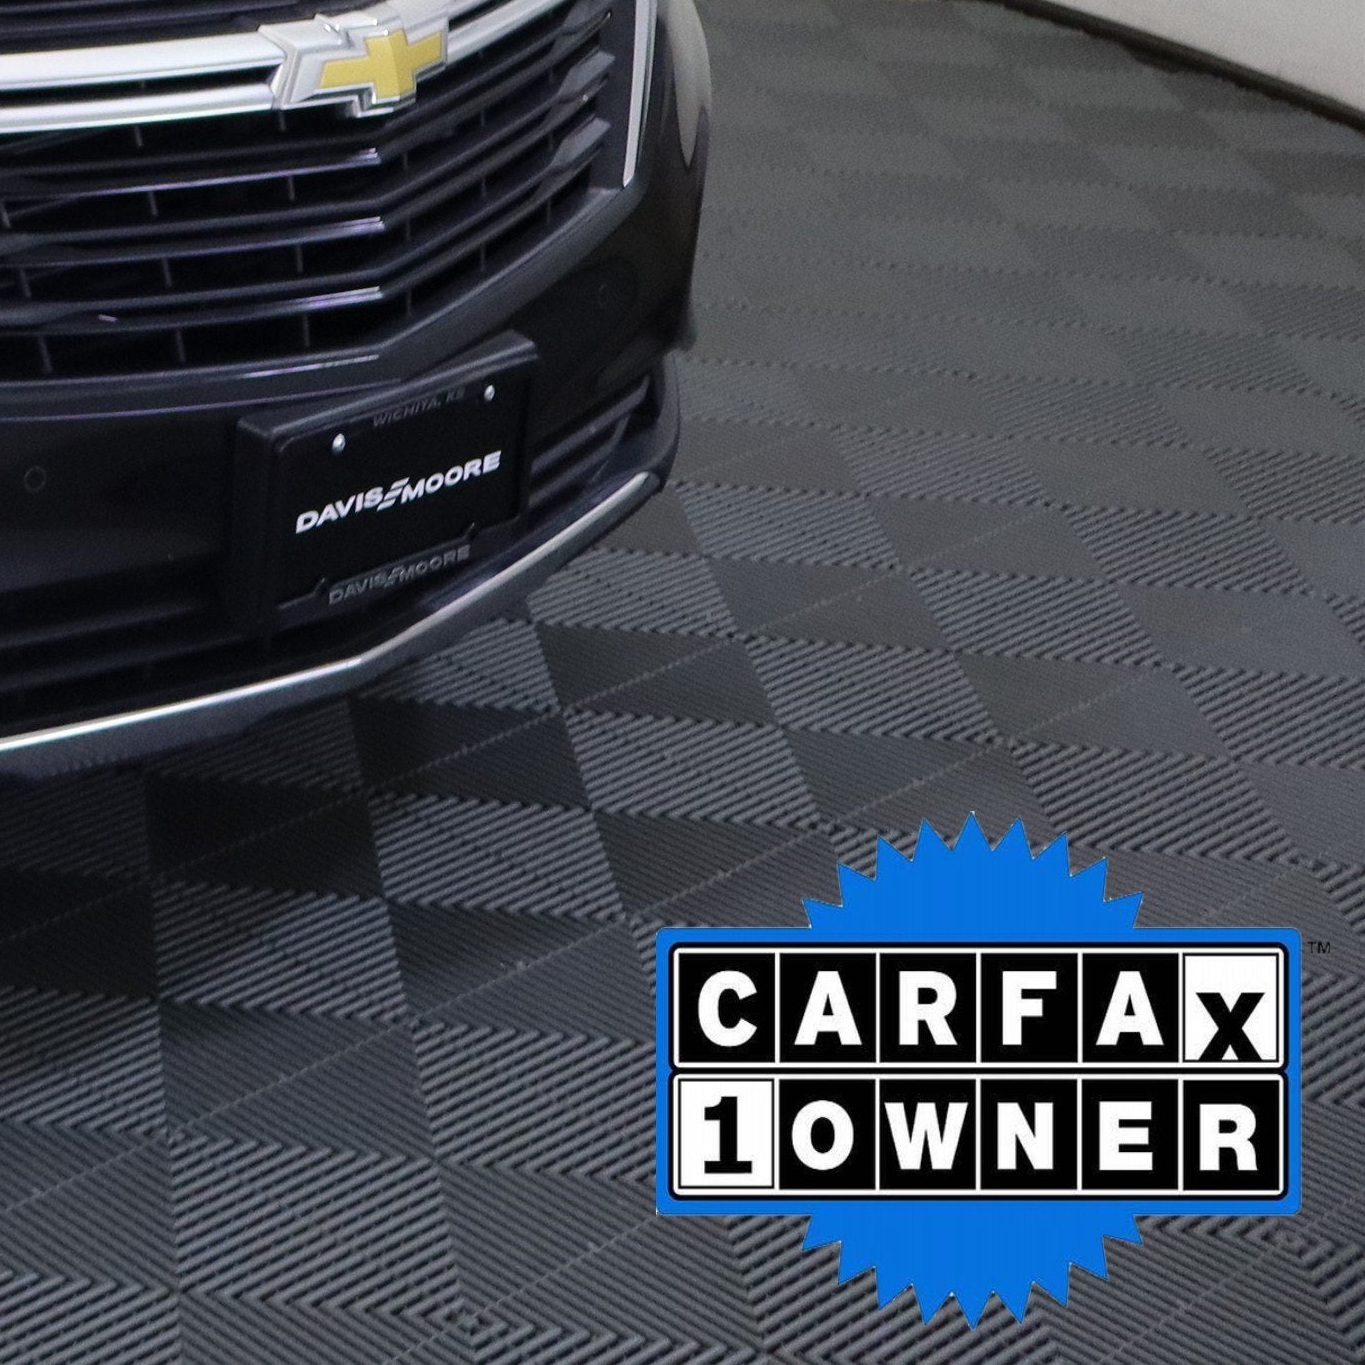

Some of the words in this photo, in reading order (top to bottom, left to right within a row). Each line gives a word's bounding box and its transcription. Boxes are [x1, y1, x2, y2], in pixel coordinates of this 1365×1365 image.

[295, 486, 385, 535] DAVIS
[400, 450, 502, 504] MOORE
[328, 571, 388, 605] DAVIS
[399, 544, 471, 583] MOORE
